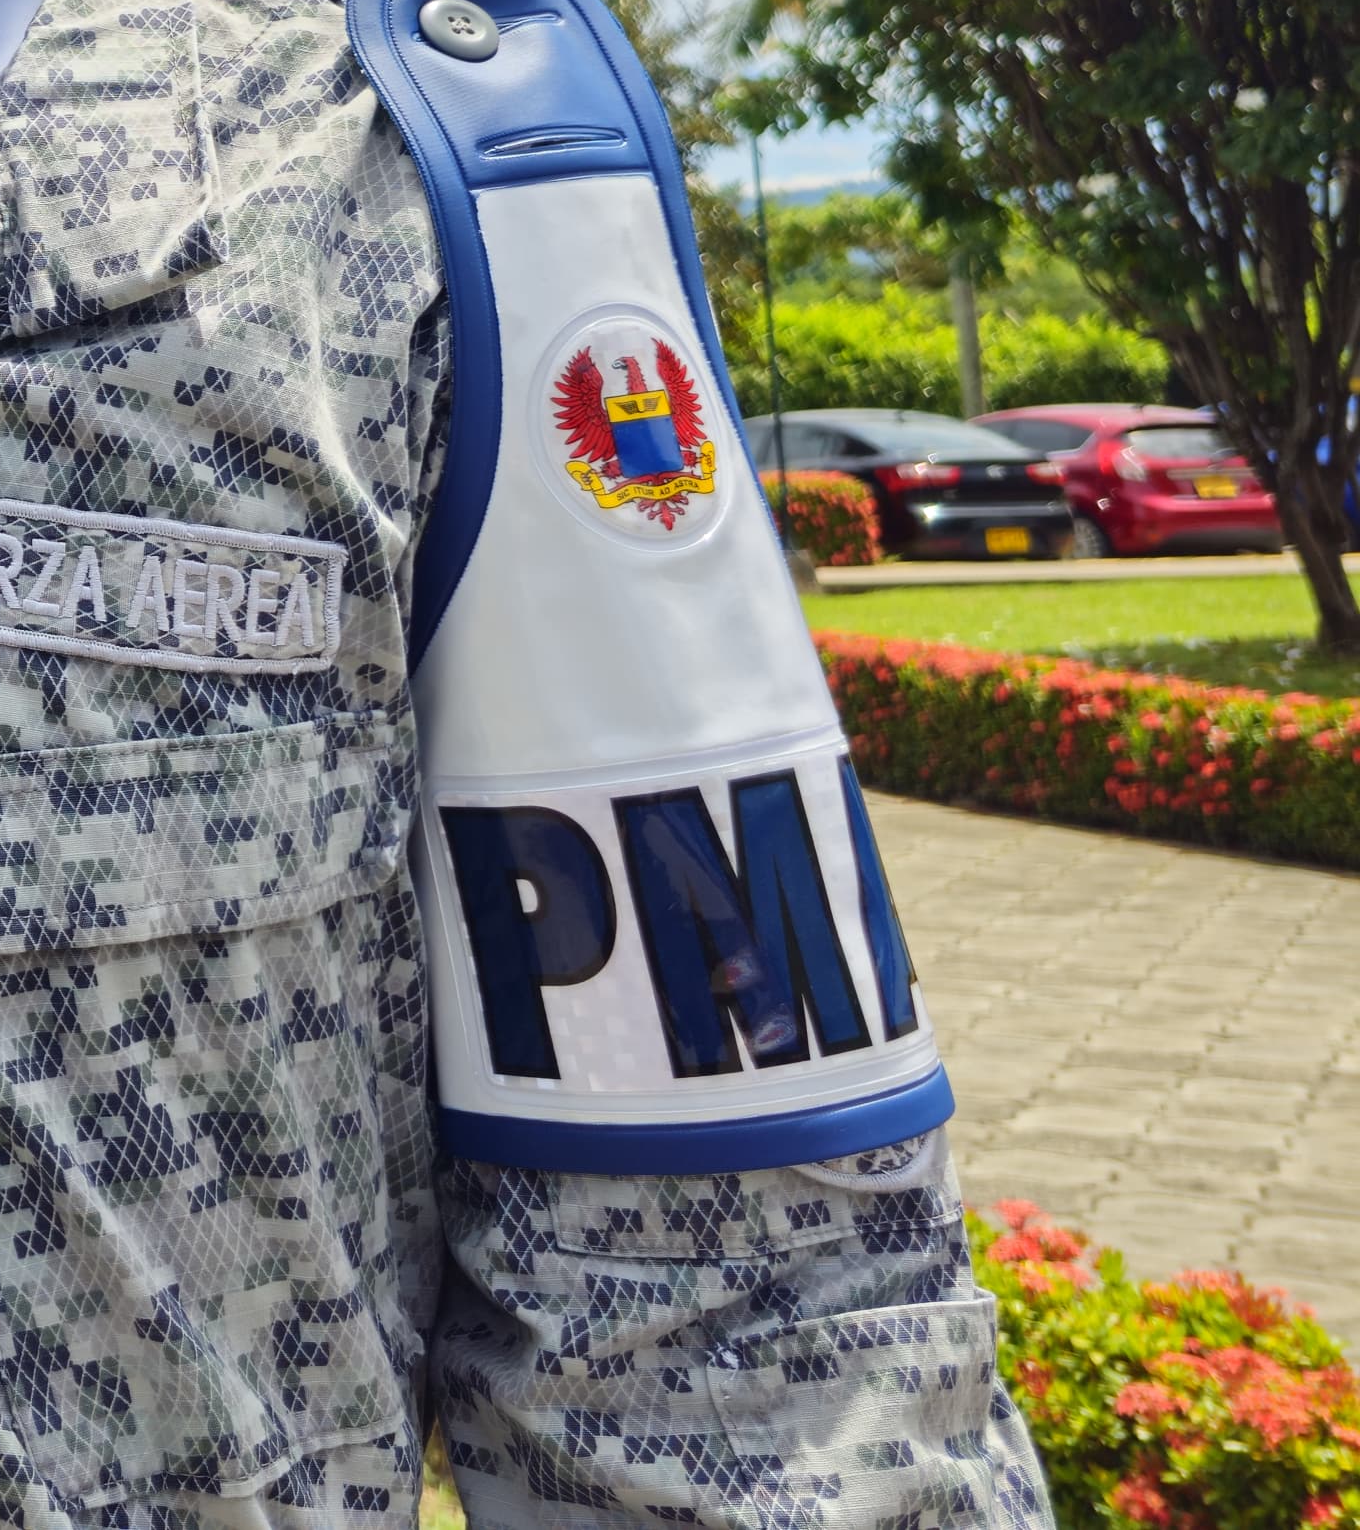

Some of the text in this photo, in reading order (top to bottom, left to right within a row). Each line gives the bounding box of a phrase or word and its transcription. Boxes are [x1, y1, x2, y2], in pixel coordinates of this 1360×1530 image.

[616, 479, 699, 501] SIC ITUR AD ASTRA
[126, 555, 316, 648] AEREA
